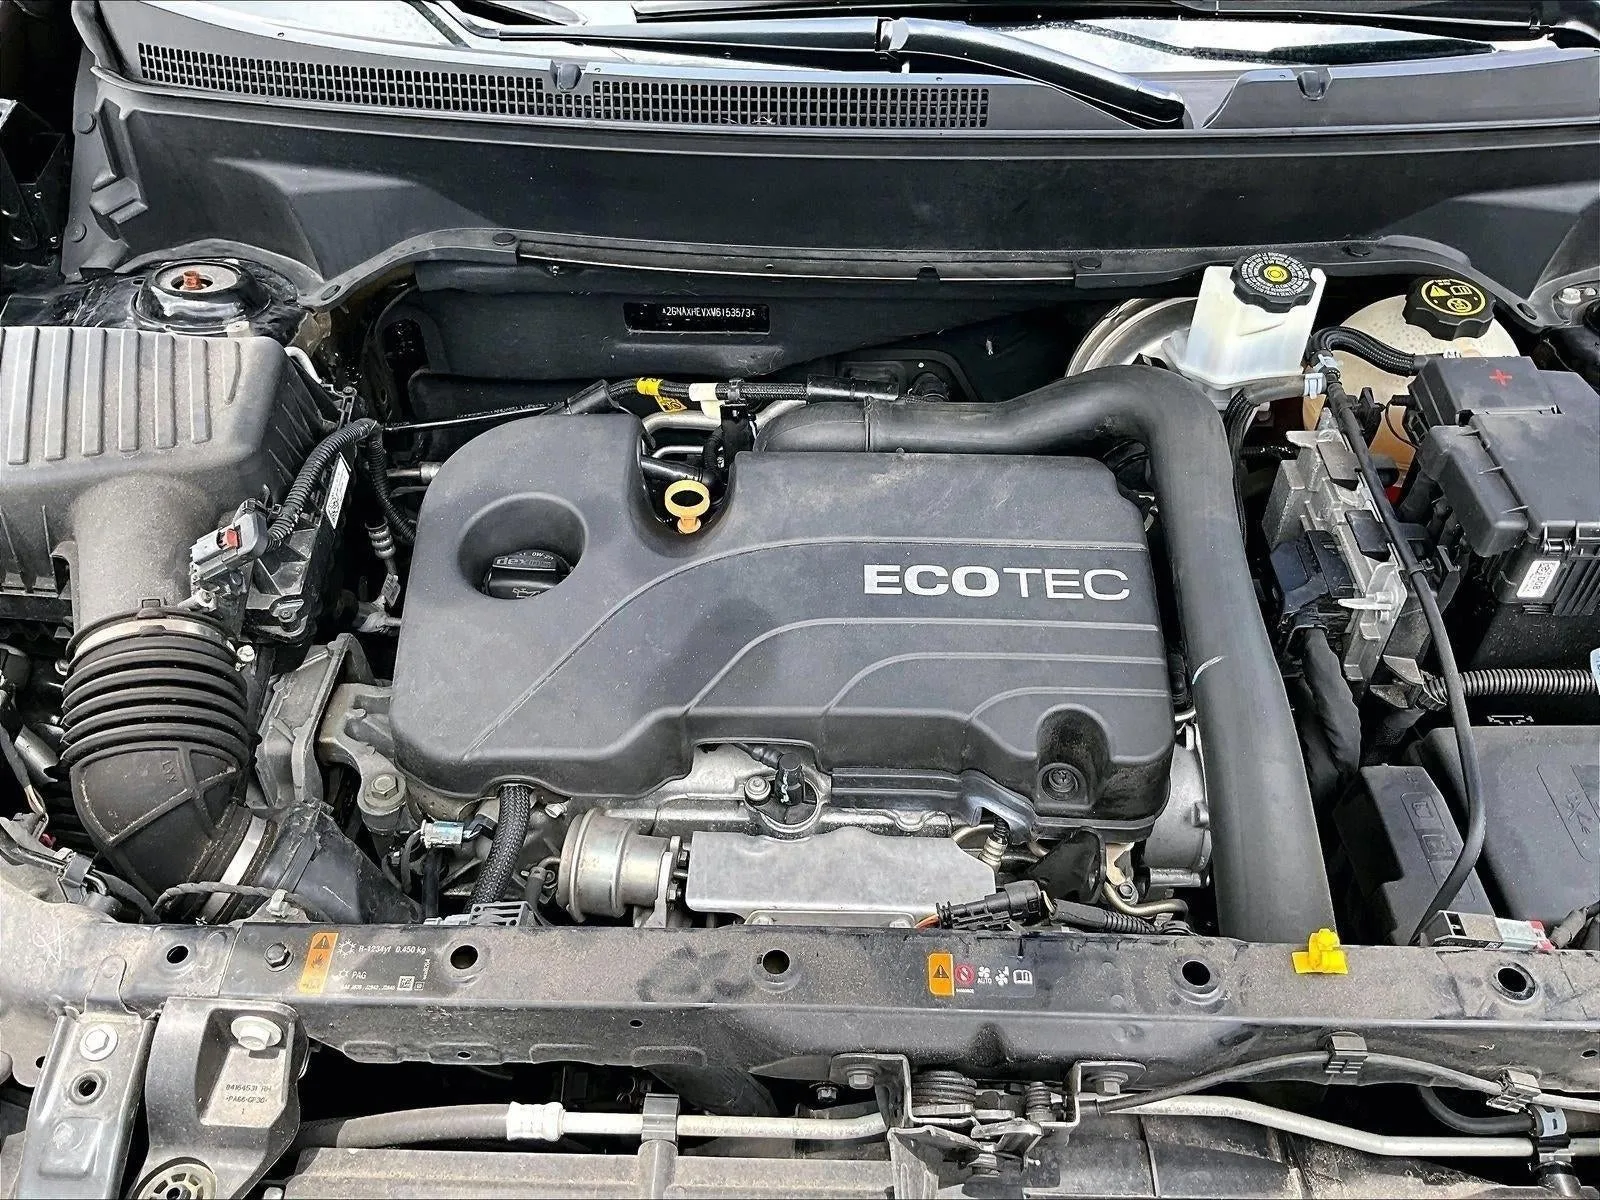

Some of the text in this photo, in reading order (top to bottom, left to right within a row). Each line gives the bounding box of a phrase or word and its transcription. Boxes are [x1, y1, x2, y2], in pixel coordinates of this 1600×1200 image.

[863, 564, 1131, 601] ECOTEC
[395, 945, 416, 953] 0.450
[416, 945, 427, 955] kg
[351, 970, 367, 979] PAG
[976, 977, 993, 985] AUTO
